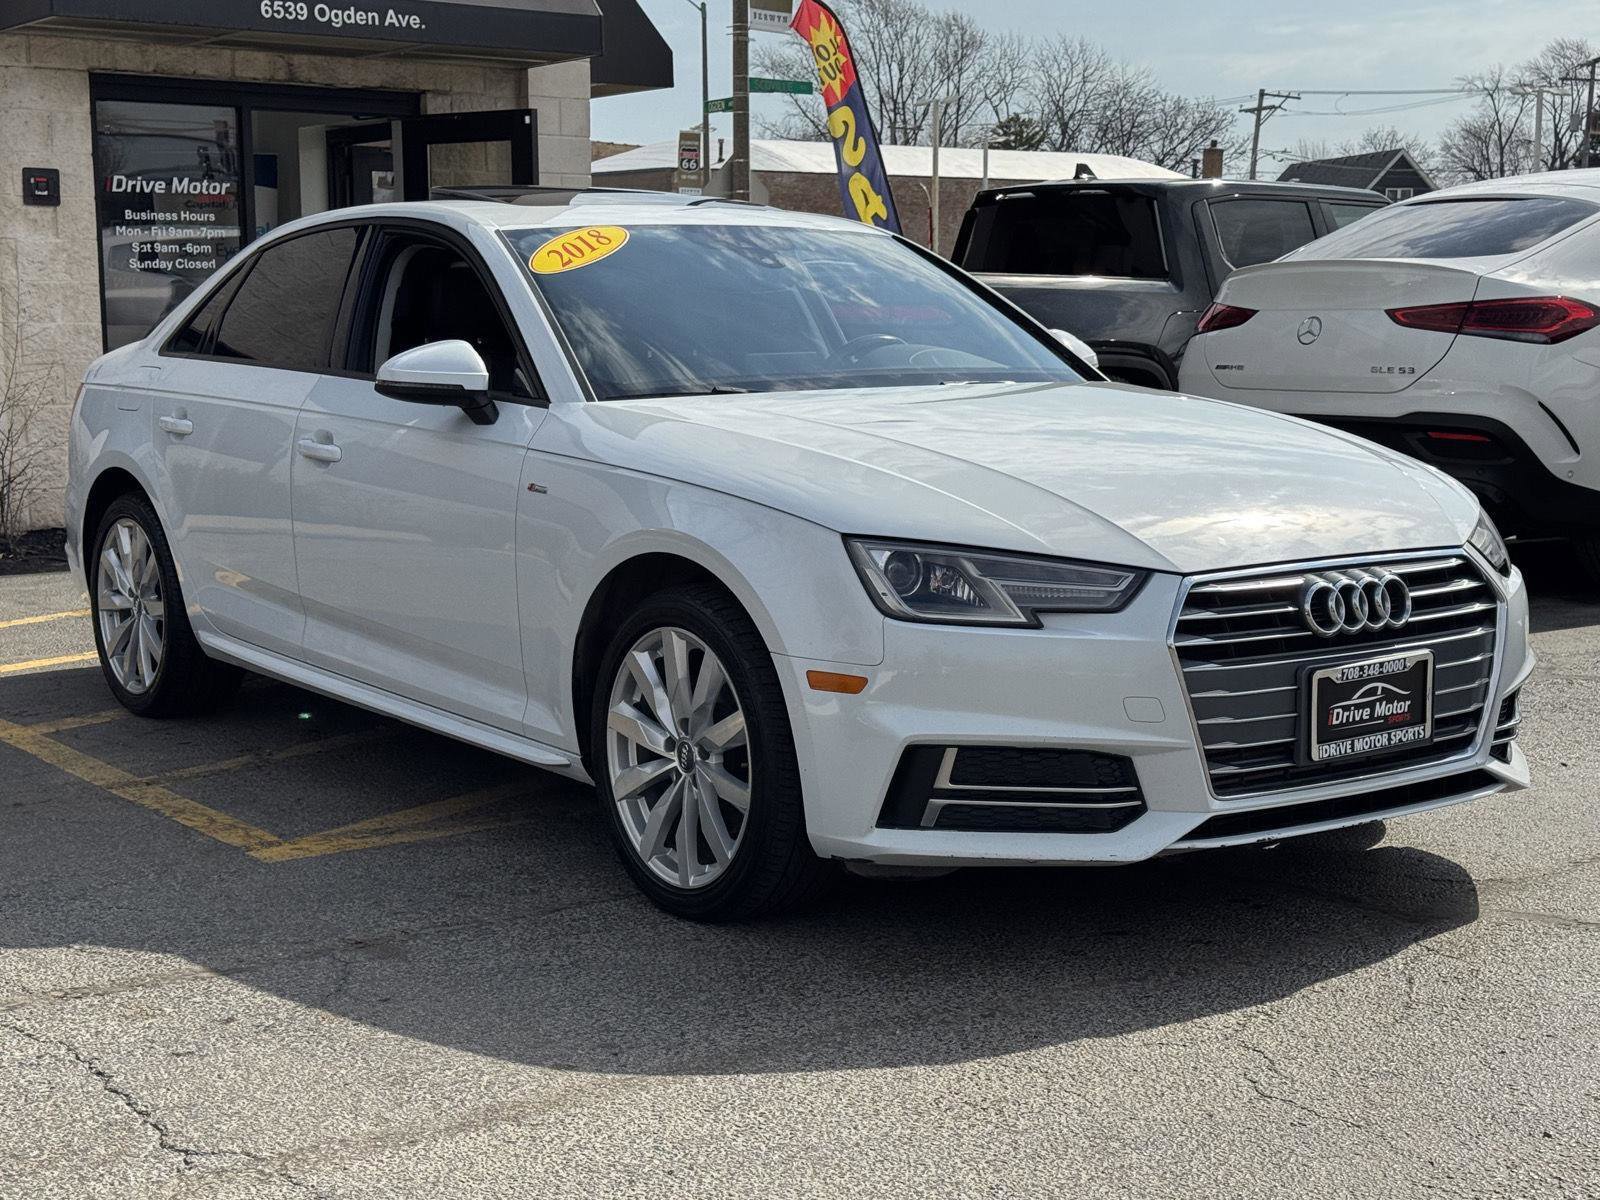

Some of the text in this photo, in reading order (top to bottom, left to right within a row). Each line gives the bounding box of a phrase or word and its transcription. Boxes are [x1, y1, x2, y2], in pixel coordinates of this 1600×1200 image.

[260, 0, 426, 29] 6539 Ogden Ave.
[682, 159, 697, 169] 66
[171, 177, 230, 195] Motor
[125, 210, 215, 222] Business Hours
[115, 225, 142, 236] Mon
[168, 227, 194, 237] 9am
[132, 242, 151, 253] Sat
[154, 243, 179, 253] 9am
[547, 229, 611, 268] 2018
[129, 258, 216, 271] Sunday Closed
[1371, 366, 1415, 375] GLE 53
[1343, 659, 1404, 681] 708-348-0000
[1328, 701, 1411, 726] iDrive Motor
[1354, 734, 1389, 752] MOTOR
[1390, 725, 1425, 744] SPORTS
